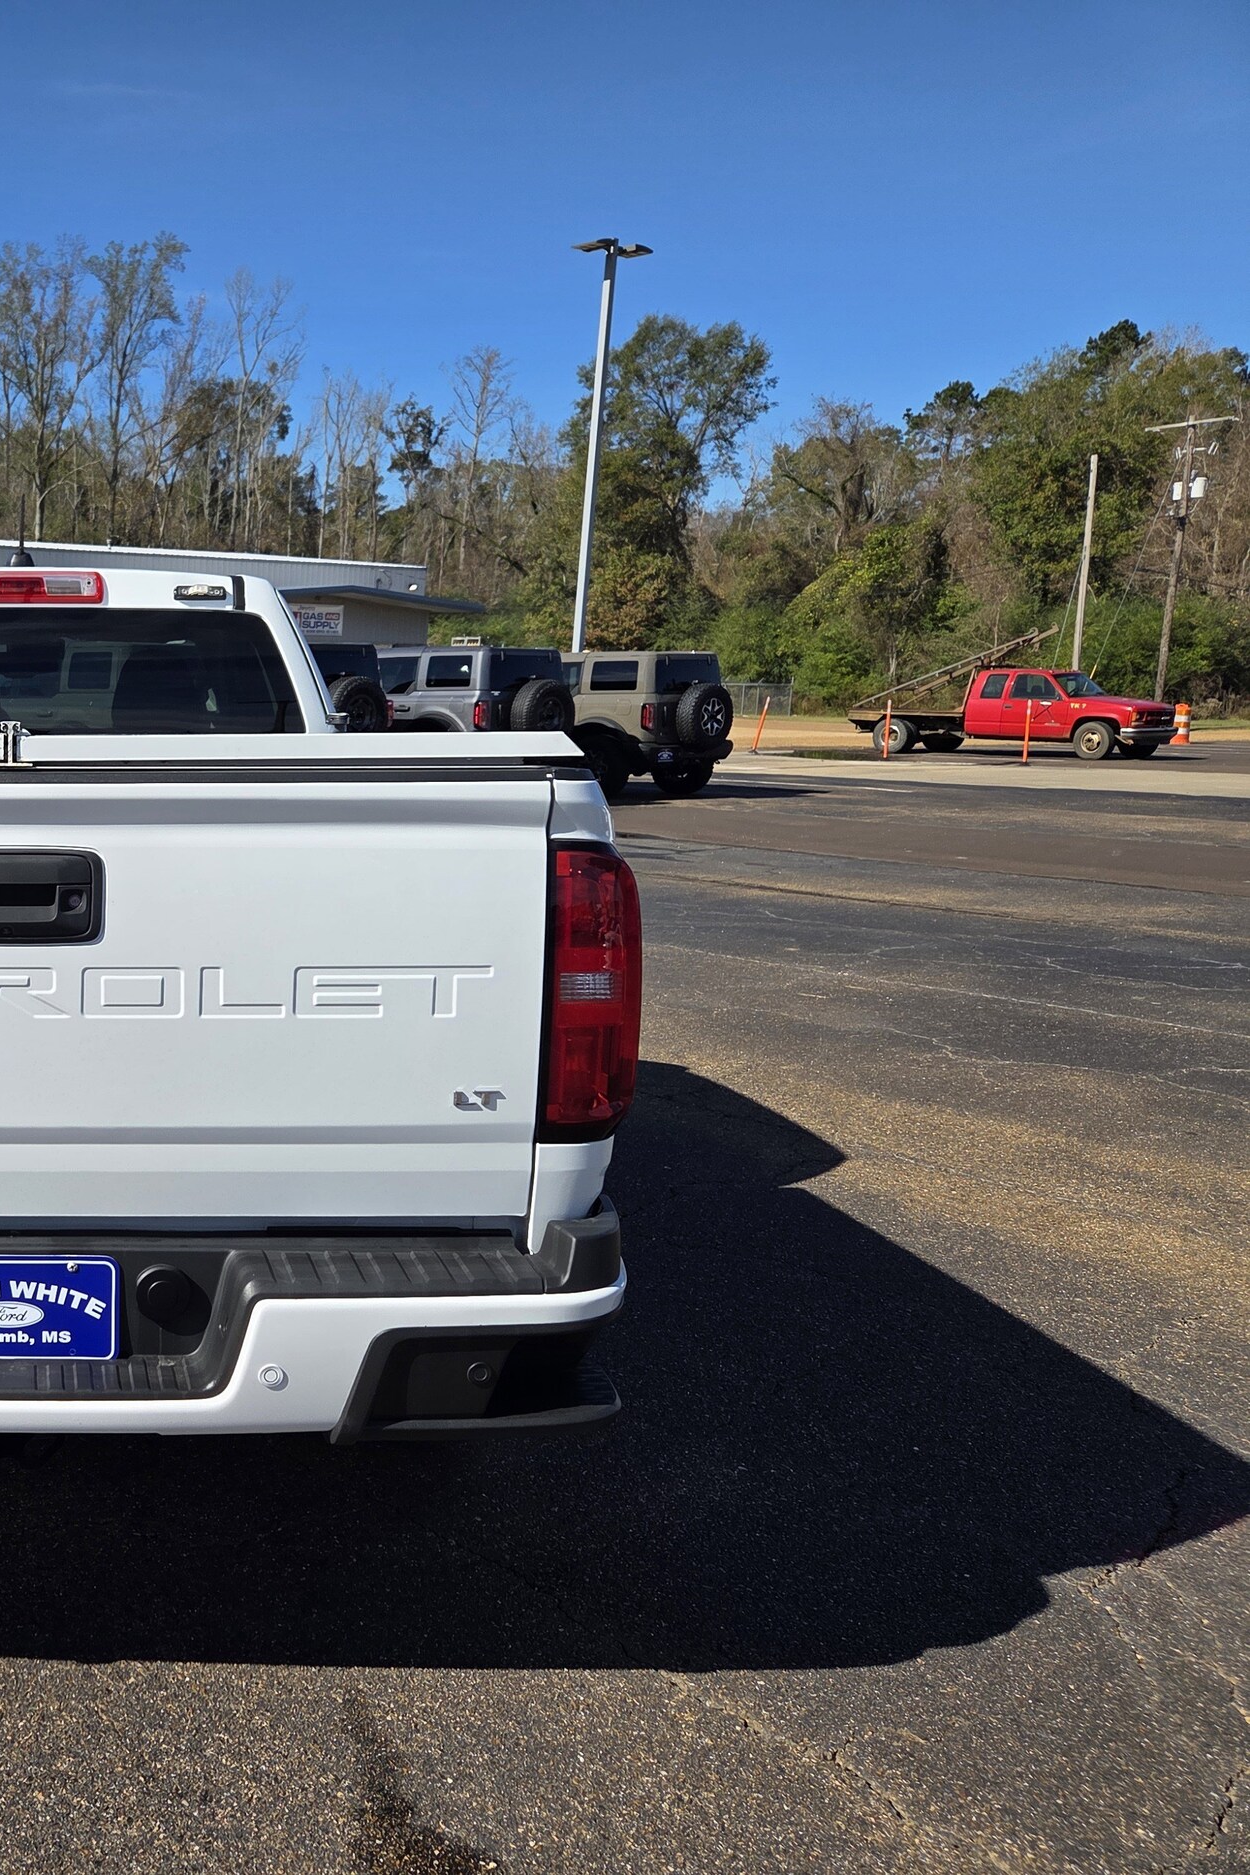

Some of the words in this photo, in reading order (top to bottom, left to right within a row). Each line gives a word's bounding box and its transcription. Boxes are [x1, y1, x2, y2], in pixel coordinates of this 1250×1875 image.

[302, 612, 324, 620] GAS
[301, 620, 341, 629] SUPPLY
[453, 1090, 507, 1112] LT
[9, 1280, 107, 1320] WHITE
[41, 1331, 72, 1344] MS
